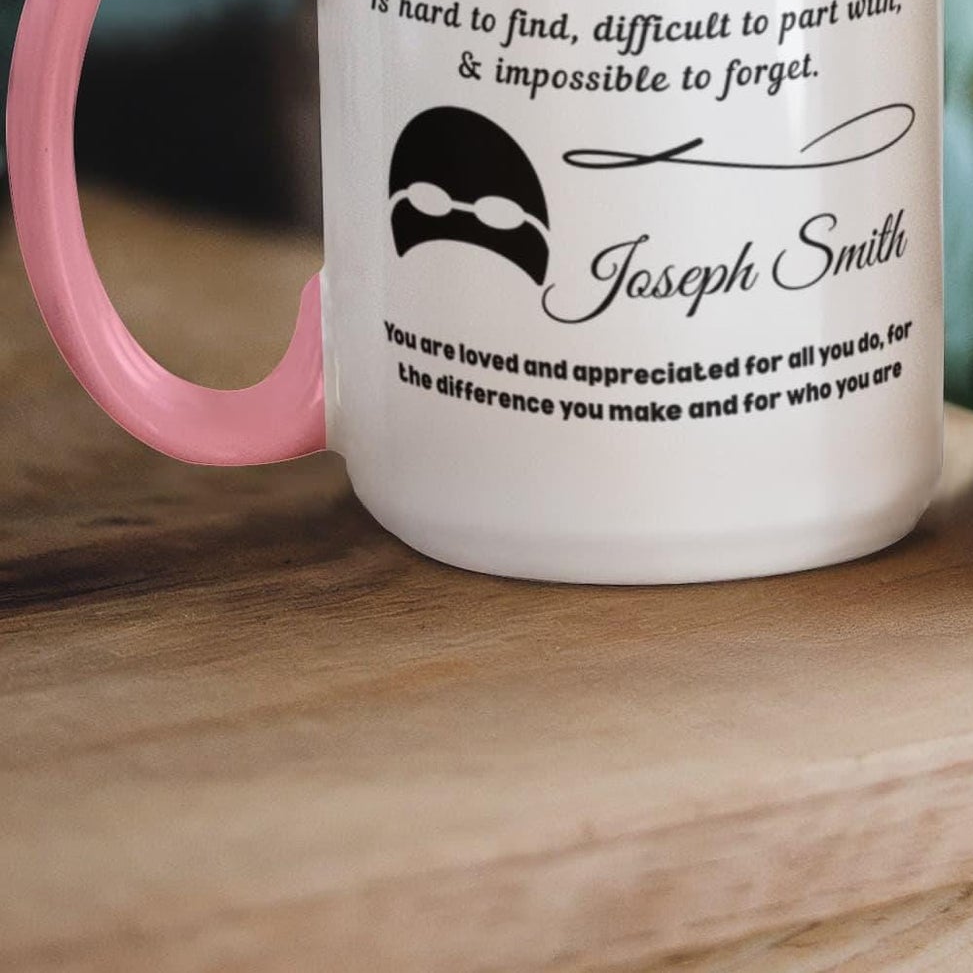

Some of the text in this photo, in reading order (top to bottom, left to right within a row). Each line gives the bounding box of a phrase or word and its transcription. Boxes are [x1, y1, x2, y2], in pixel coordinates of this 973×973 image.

[470, 6, 497, 34] to
[499, 7, 579, 49] find,
[593, 12, 731, 57] difficult
[742, 11, 769, 37] to
[778, 0, 838, 45] part
[458, 50, 818, 102] & impossible to forget.
[541, 208, 908, 325] Joseph Smith
[383, 320, 913, 388] You are loved and appreciated for all you do, for
[397, 361, 903, 423] the difference you make and for who you are
